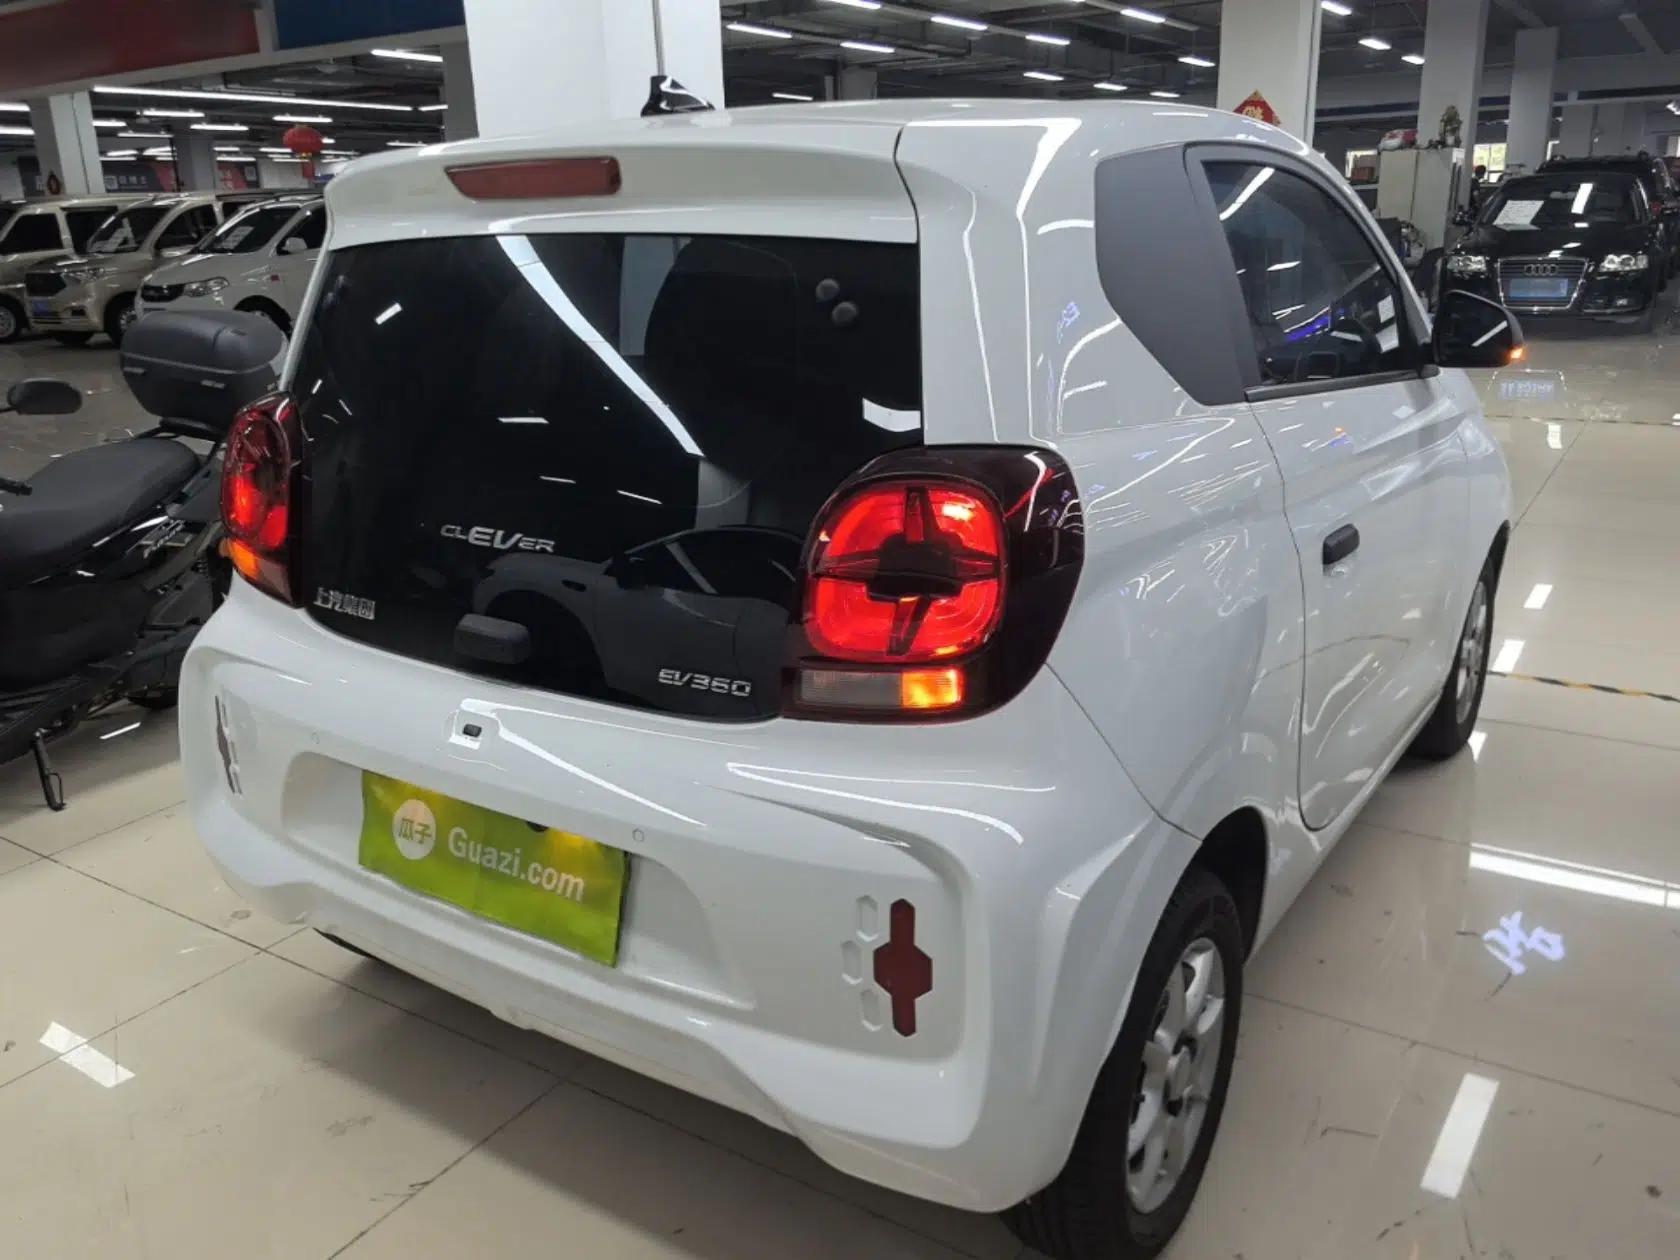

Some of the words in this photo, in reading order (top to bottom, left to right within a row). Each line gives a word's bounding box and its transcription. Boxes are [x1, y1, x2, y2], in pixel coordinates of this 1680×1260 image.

[440, 524, 555, 552] CLEVER
[658, 668, 751, 697] EV360
[398, 817, 432, 845] 瓜子
[448, 826, 585, 902] Guazi.com
